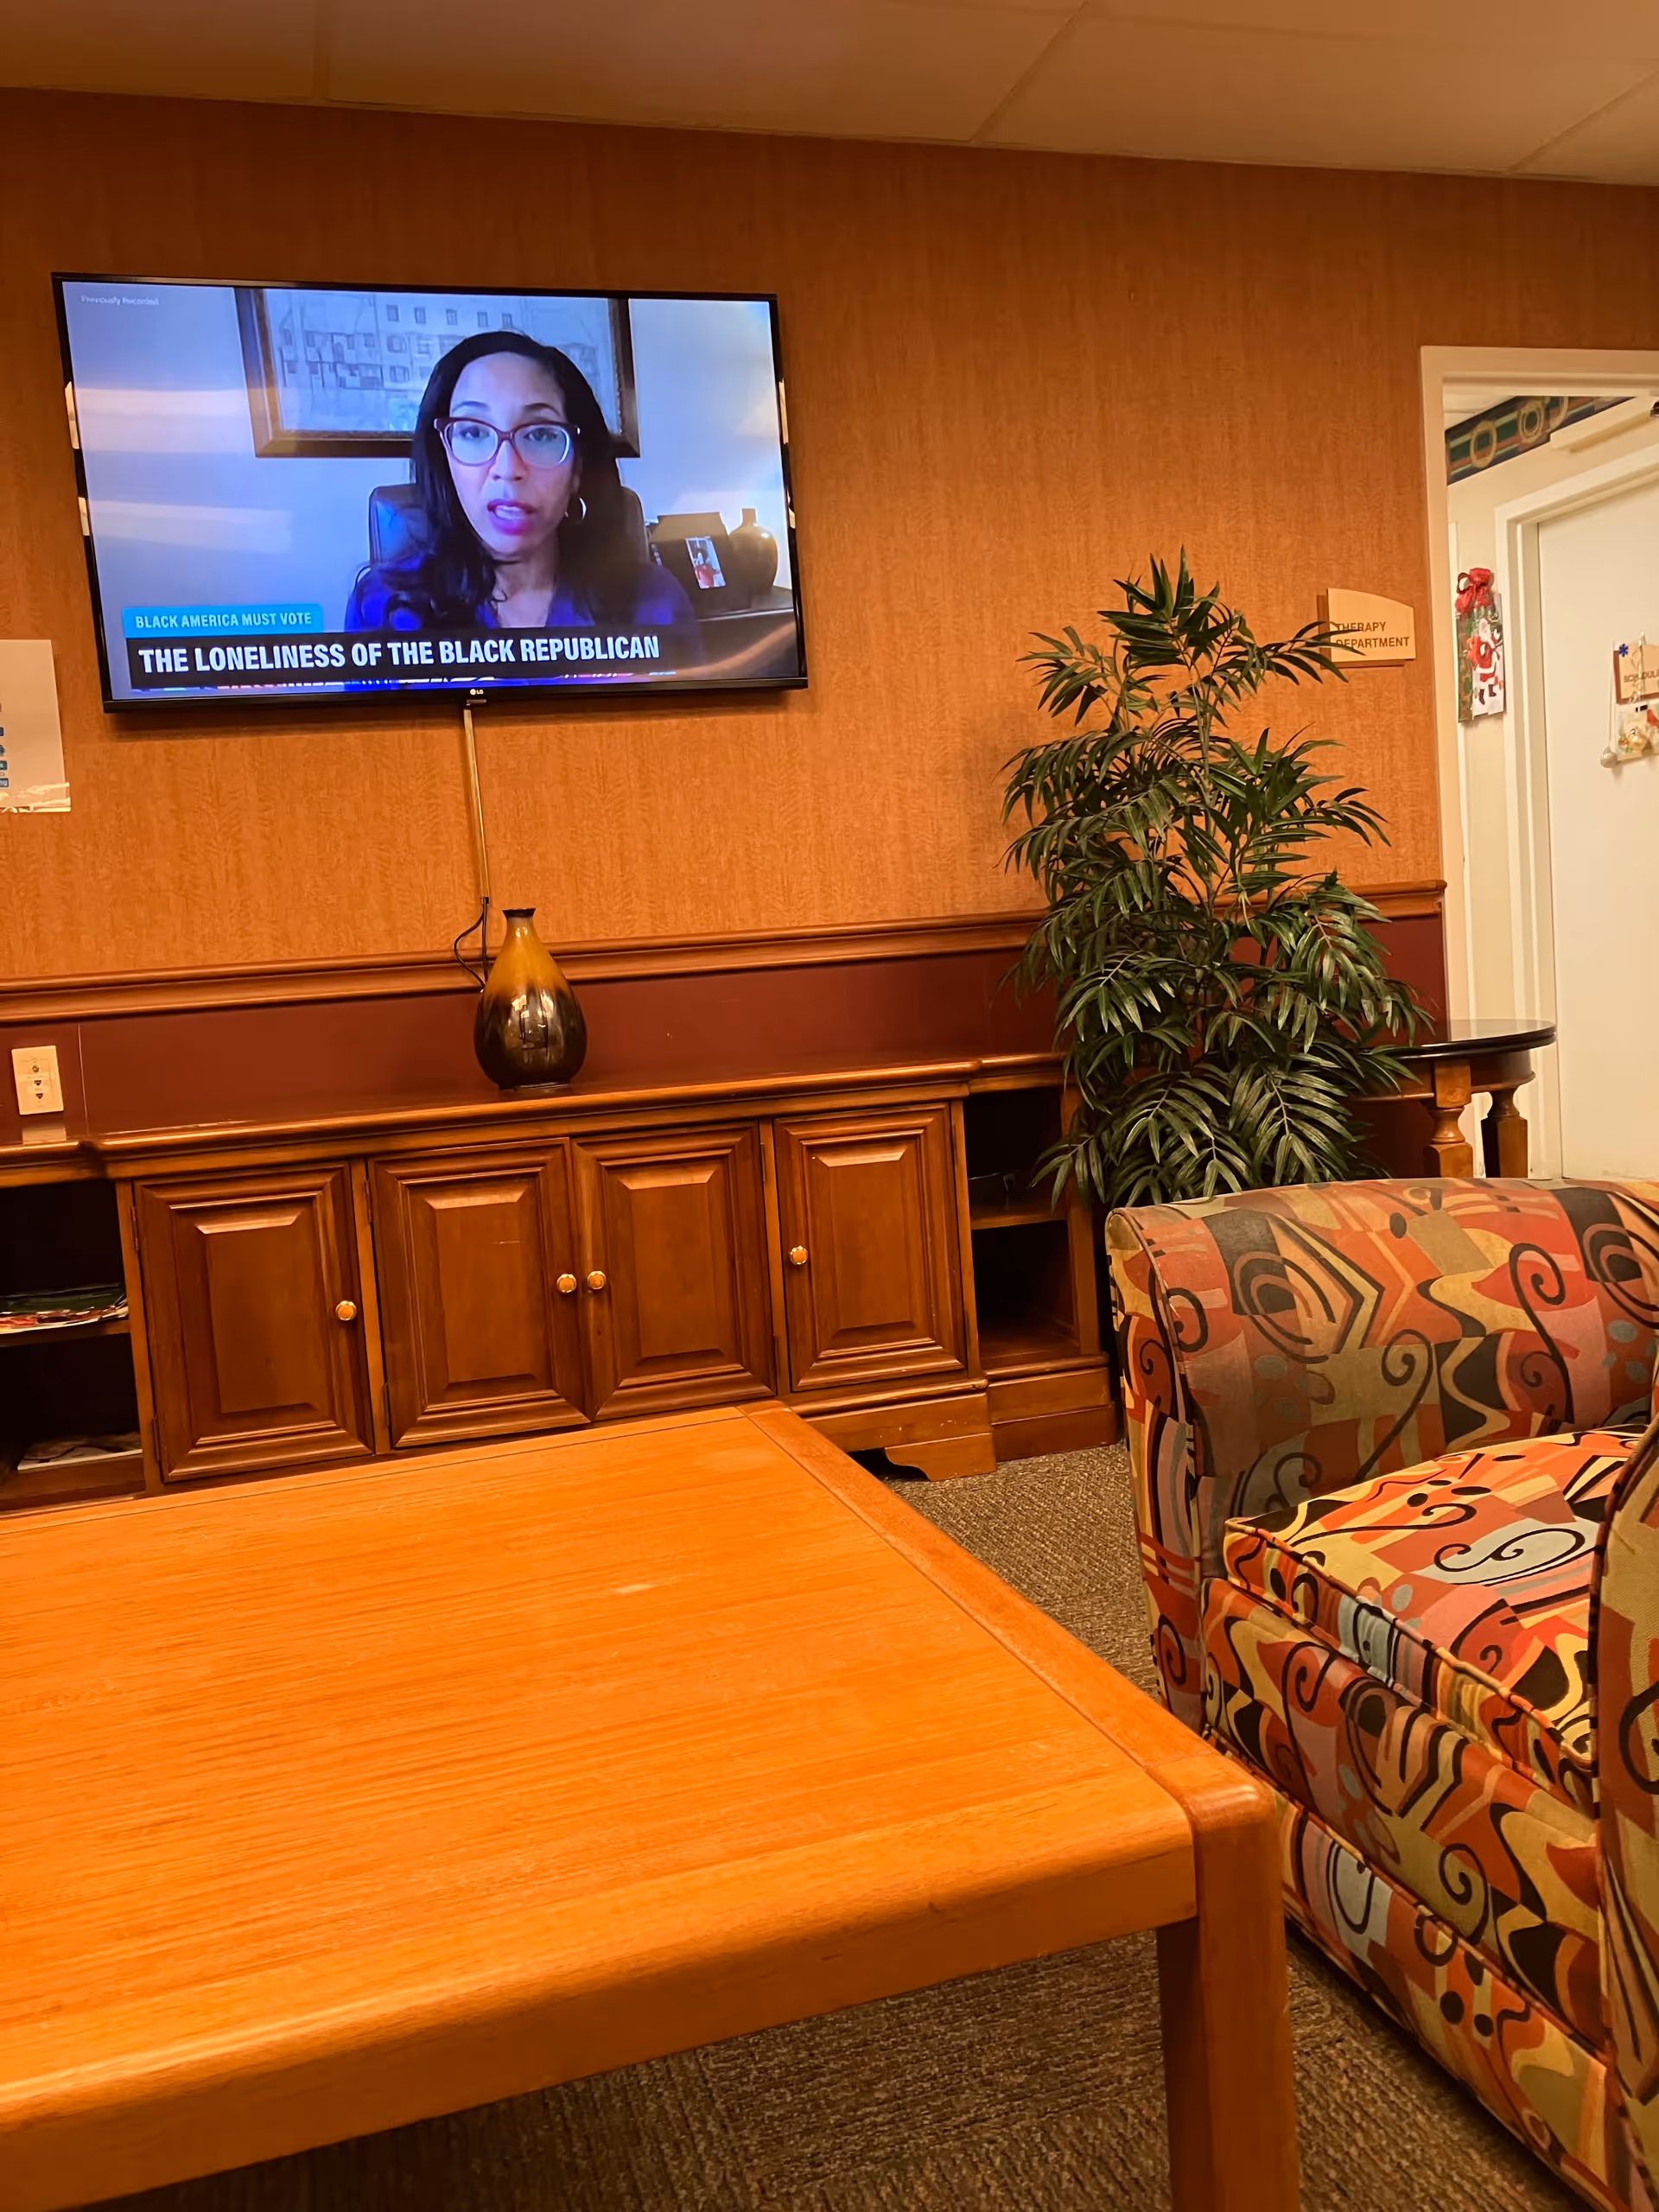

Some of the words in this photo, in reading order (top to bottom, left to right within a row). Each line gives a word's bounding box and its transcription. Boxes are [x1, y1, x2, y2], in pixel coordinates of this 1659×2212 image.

[136, 615, 178, 628] BLACK
[181, 613, 238, 627] AMERICA
[241, 613, 277, 626] MUST
[279, 612, 312, 625] VOTE
[1336, 621, 1386, 632] THERAPY
[138, 649, 189, 673] THE
[194, 644, 346, 671] LONELINESS
[351, 643, 382, 666] OF
[387, 640, 434, 664] THE
[438, 639, 516, 663] BLACK
[519, 635, 659, 662] REPUBLICAN
